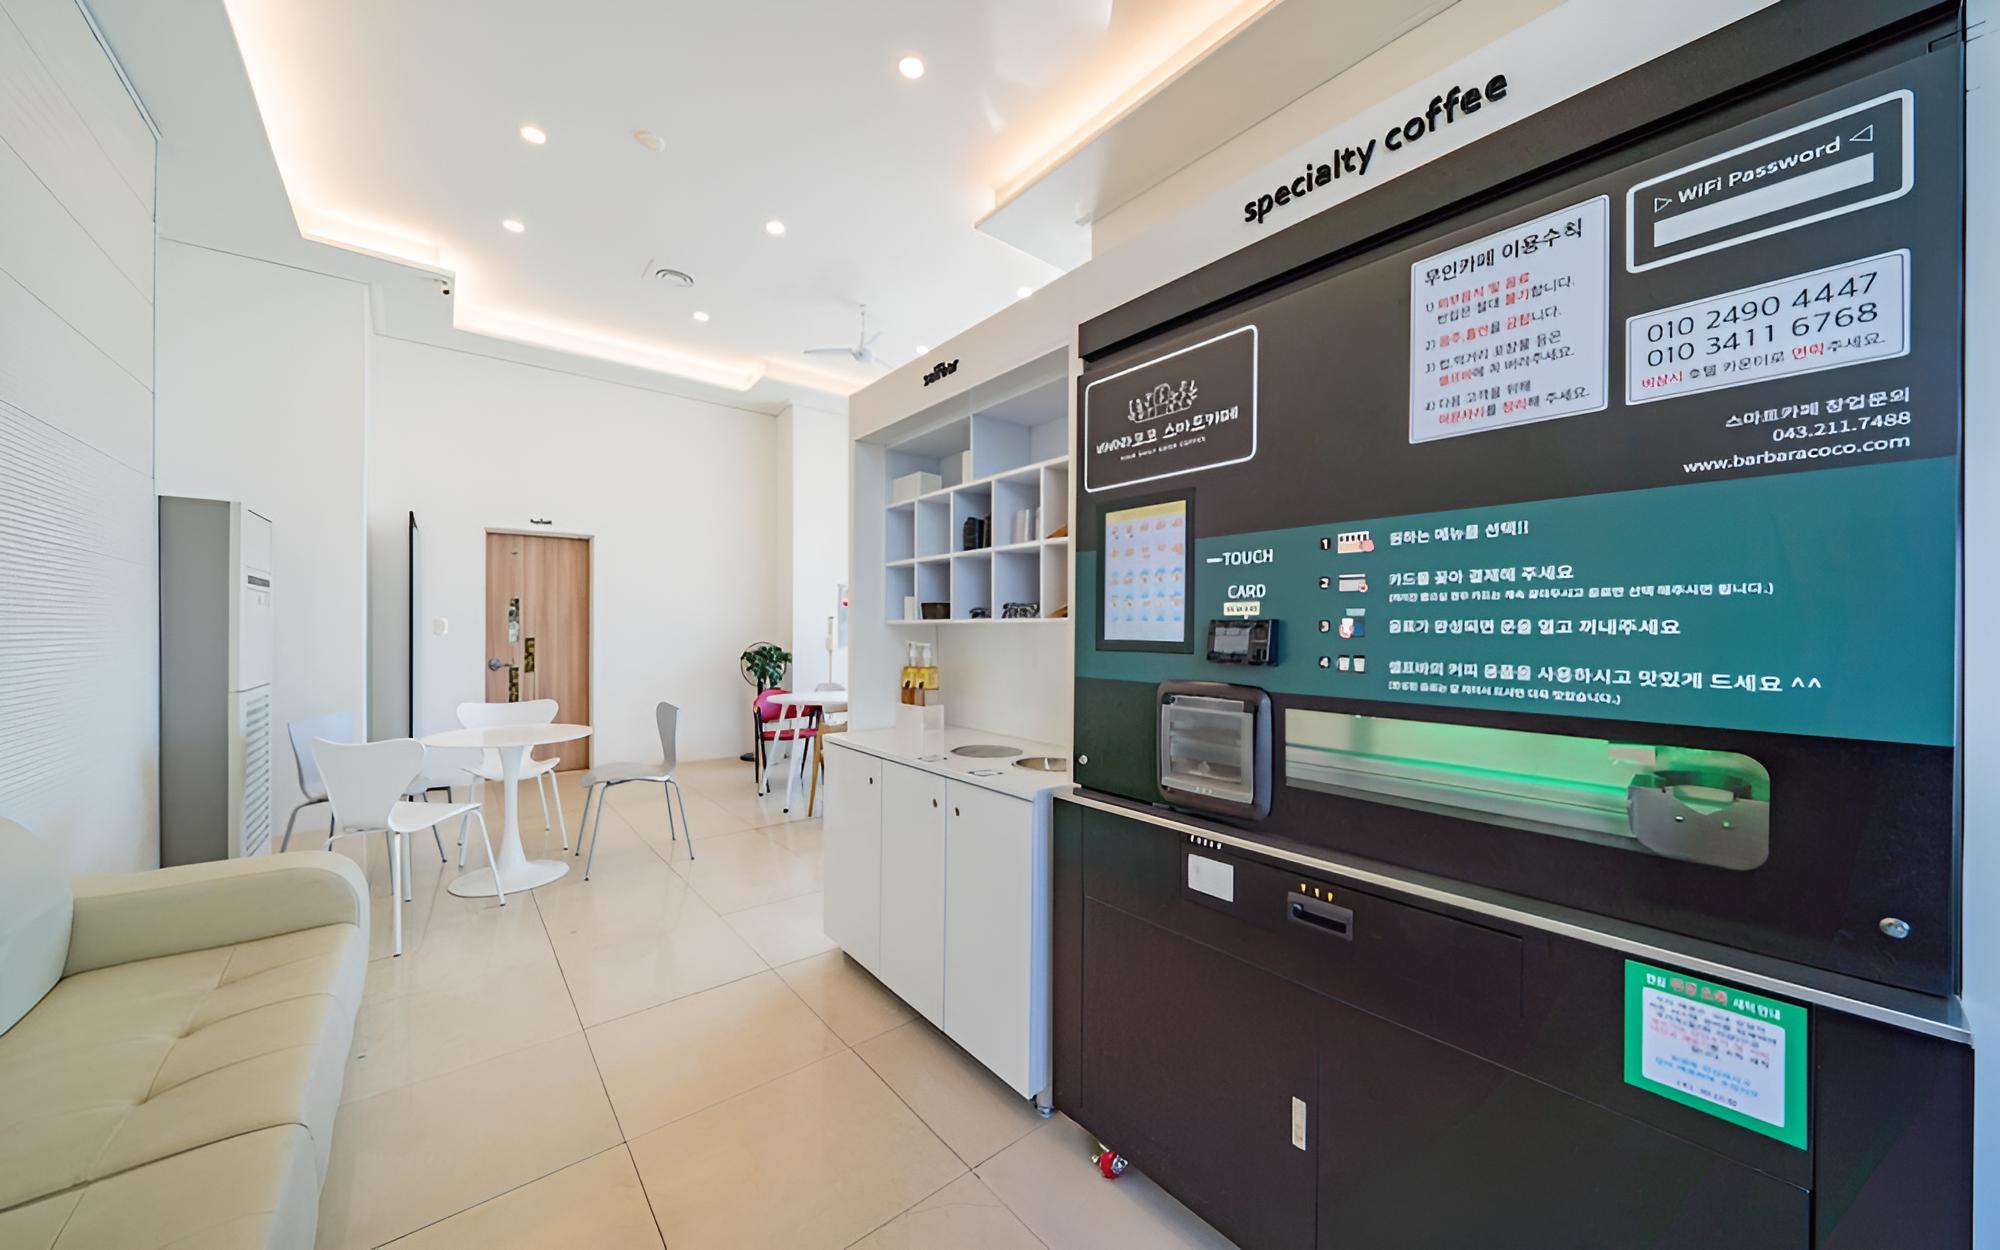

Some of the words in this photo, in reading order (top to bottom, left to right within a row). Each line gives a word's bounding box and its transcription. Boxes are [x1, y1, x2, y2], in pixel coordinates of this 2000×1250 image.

[1244, 139, 1376, 224] specialty
[1384, 74, 1508, 151] coffee
[1678, 176, 1722, 203] WiFi
[1728, 136, 1840, 187] Password
[1425, 249, 1495, 286] 무인카페
[1502, 217, 1582, 259] 이용수칙
[1647, 316, 1694, 343] 010
[1706, 296, 1780, 330] 2490
[1791, 271, 1878, 308] 4447
[1647, 342, 1695, 367] 010
[1706, 324, 1774, 356] 3411
[1791, 302, 1878, 337] 6768
[1725, 400, 1819, 428] 스마트카페
[1772, 411, 1911, 442] 043.211.7488
[1681, 435, 1910, 473] www.barbaracoco.com
[1390, 529, 1430, 546] 원하는
[1434, 524, 1479, 542] 메뉴를
[1388, 571, 1430, 586] 카드를
[1521, 565, 1574, 580] 주세요
[1228, 584, 1266, 599] CARD
[1388, 619, 1428, 634] 음료가
[1501, 619, 1531, 635] 문을
[1537, 619, 1573, 635] 열고
[1449, 662, 1477, 678] 커피
[1537, 665, 1632, 684] 사용하시고
[1638, 670, 1703, 689] 맛있게
[1710, 674, 1783, 692] 드세요
